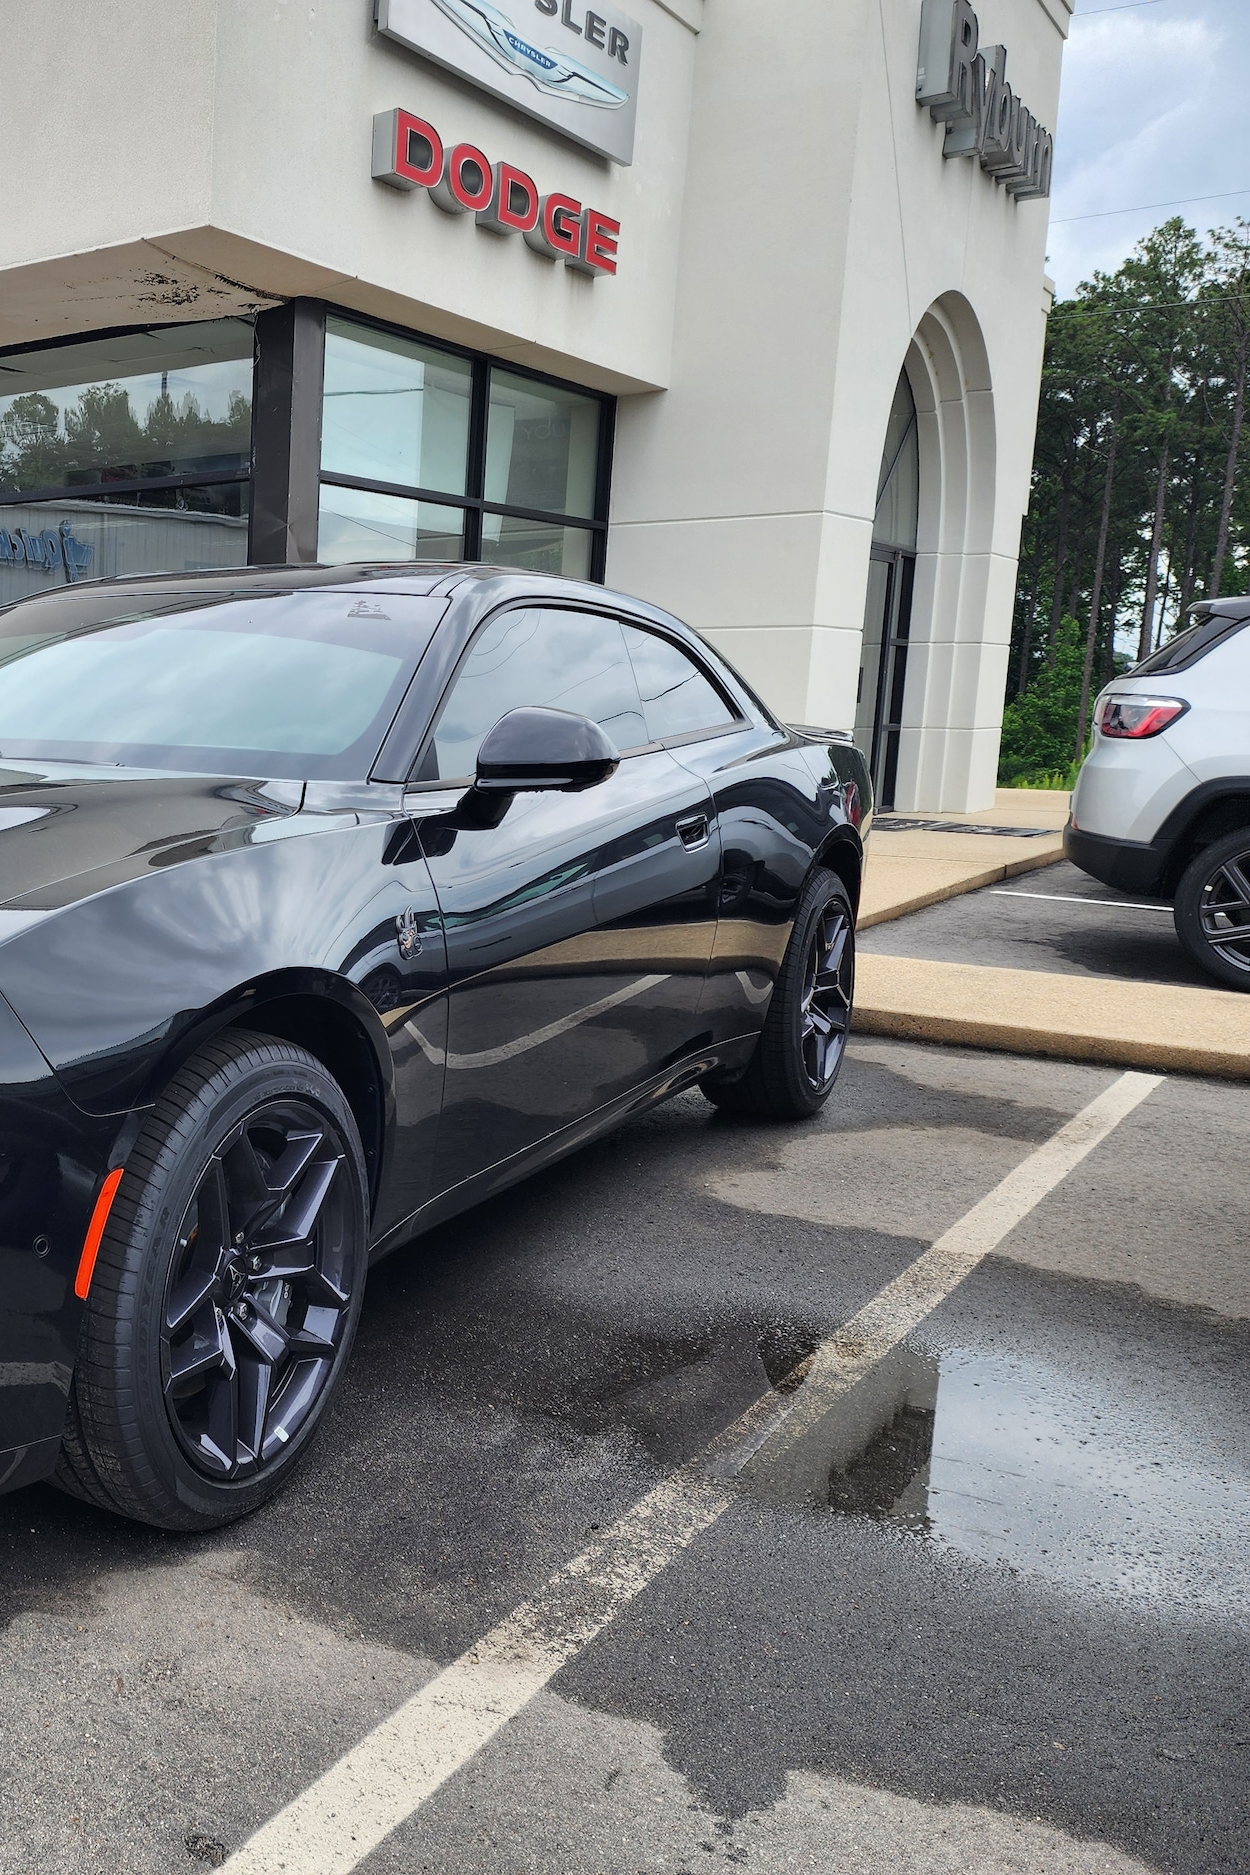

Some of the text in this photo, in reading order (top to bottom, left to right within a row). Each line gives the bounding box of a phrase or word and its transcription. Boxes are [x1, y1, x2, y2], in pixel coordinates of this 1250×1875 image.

[508, 36, 552, 68] CHRYSLER
[924, 0, 1053, 201] Ryburn
[376, 107, 621, 277] DODGE
